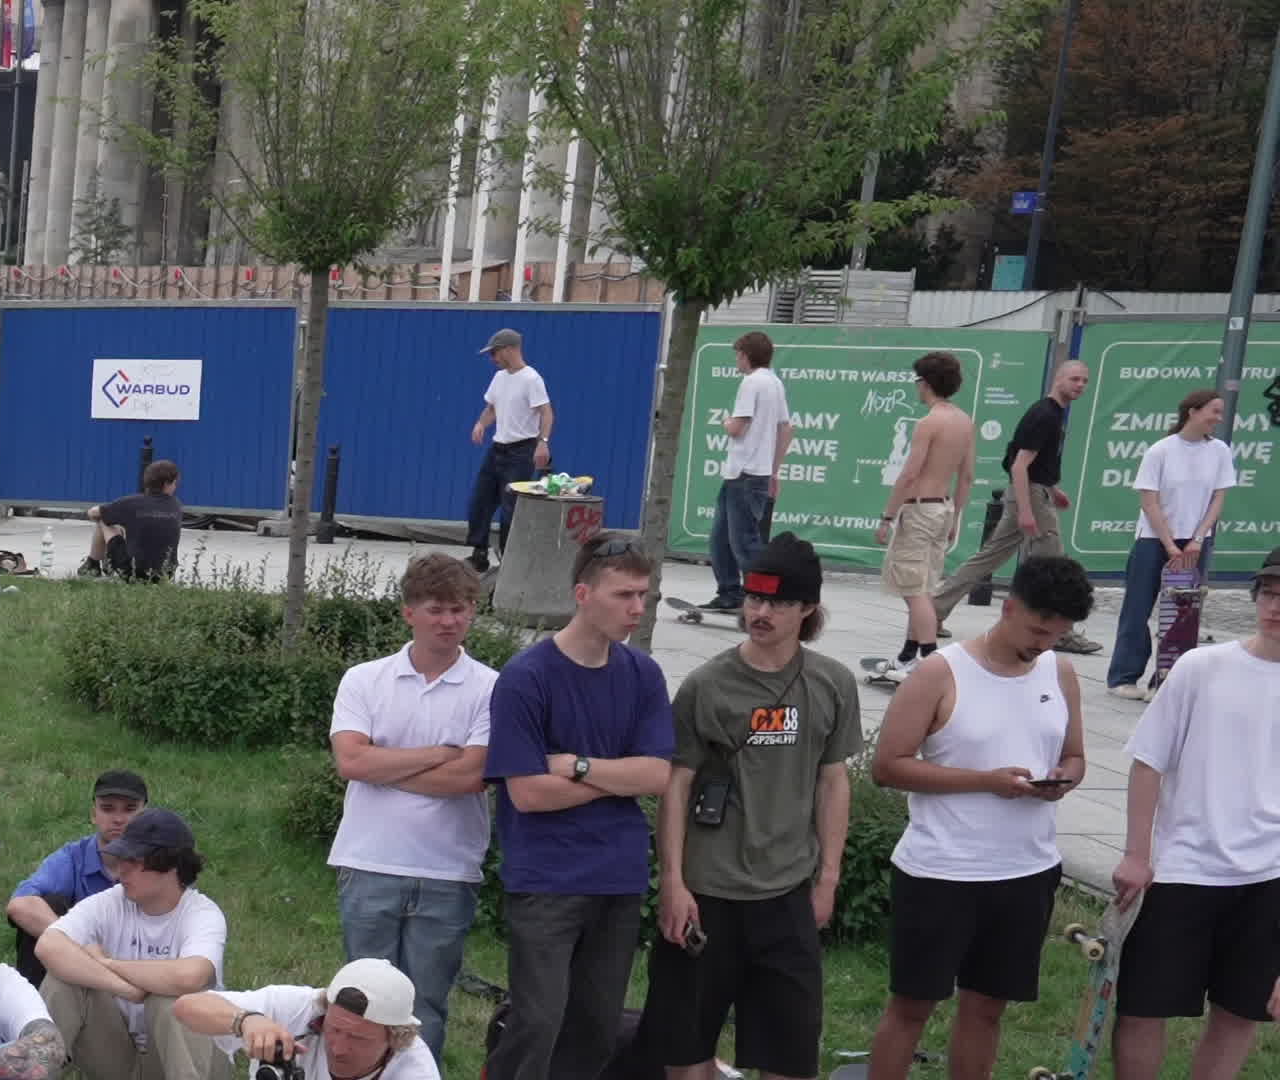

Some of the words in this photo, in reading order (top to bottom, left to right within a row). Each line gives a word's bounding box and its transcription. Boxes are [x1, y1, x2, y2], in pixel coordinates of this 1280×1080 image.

[780, 368, 838, 381] TEATRU
[839, 370, 858, 382] TR
[1119, 367, 1201, 379] BUDOWA
[1207, 367, 1277, 379] TTRU
[116, 383, 191, 396] WARBUD
[813, 514, 832, 526] ZA
[1233, 521, 1258, 533] ZA
